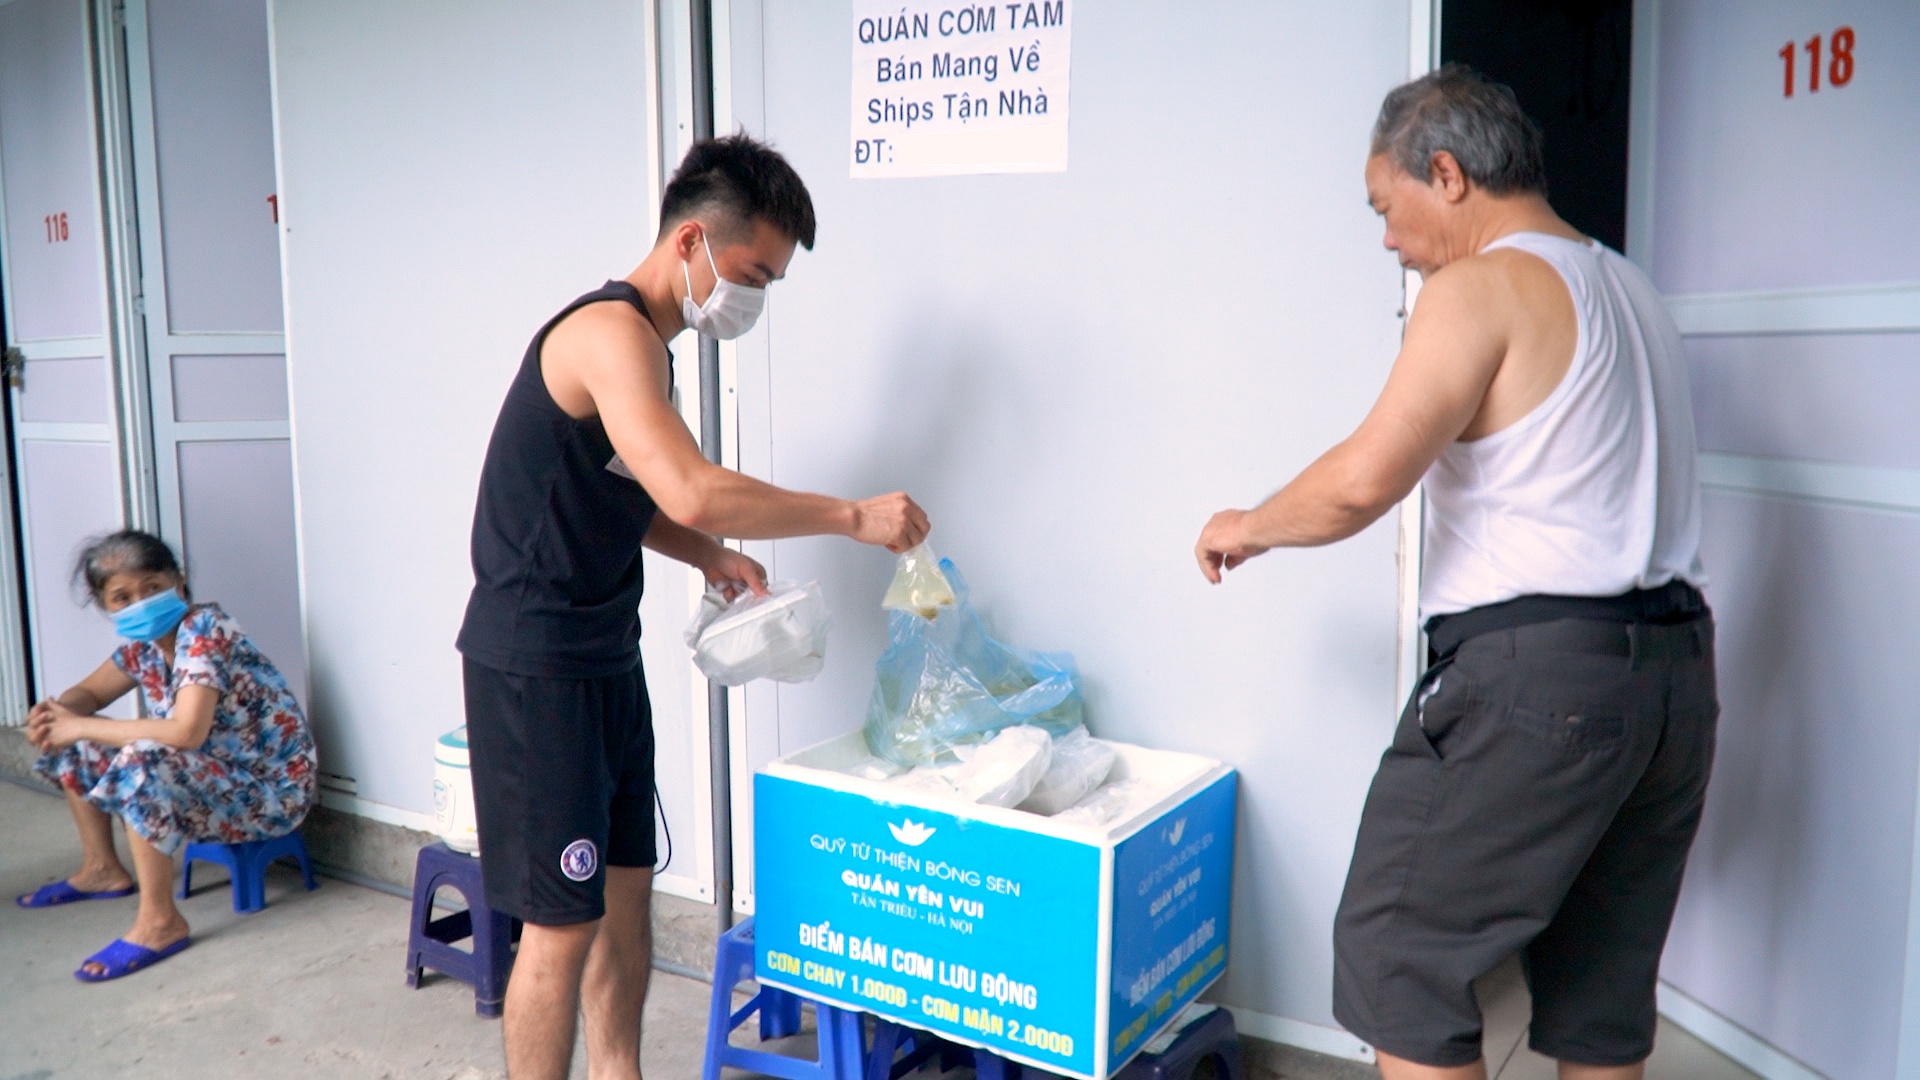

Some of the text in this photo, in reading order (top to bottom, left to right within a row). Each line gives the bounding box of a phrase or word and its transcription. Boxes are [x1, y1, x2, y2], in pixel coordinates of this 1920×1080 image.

[858, 7, 929, 44] QUÁN
[938, 4, 996, 37] CƠM
[877, 39, 1041, 83] Bán Mang Về
[1778, 24, 1855, 98] 118
[867, 86, 1048, 129] Ships Tận Nhà
[855, 138, 893, 164] ĐT:
[43, 211, 70, 243] 116
[810, 834, 847, 854] QUỸ
[874, 848, 920, 872] THIỆN
[925, 861, 981, 886] BÔNG
[986, 875, 1021, 897] SEN
[841, 869, 984, 919] QUÁN YÊN VUI
[851, 891, 877, 908] TÂN
[927, 911, 946, 927] HÀ
[949, 917, 974, 935] NỘI
[799, 920, 1037, 1010] ĐIỂM BÁN CƠM LƯU ĐỘNG
[767, 950, 800, 976] CƠM
[803, 960, 846, 989] CHAY
[922, 994, 959, 1024] CƠM
[963, 1006, 1003, 1036] MẶN
